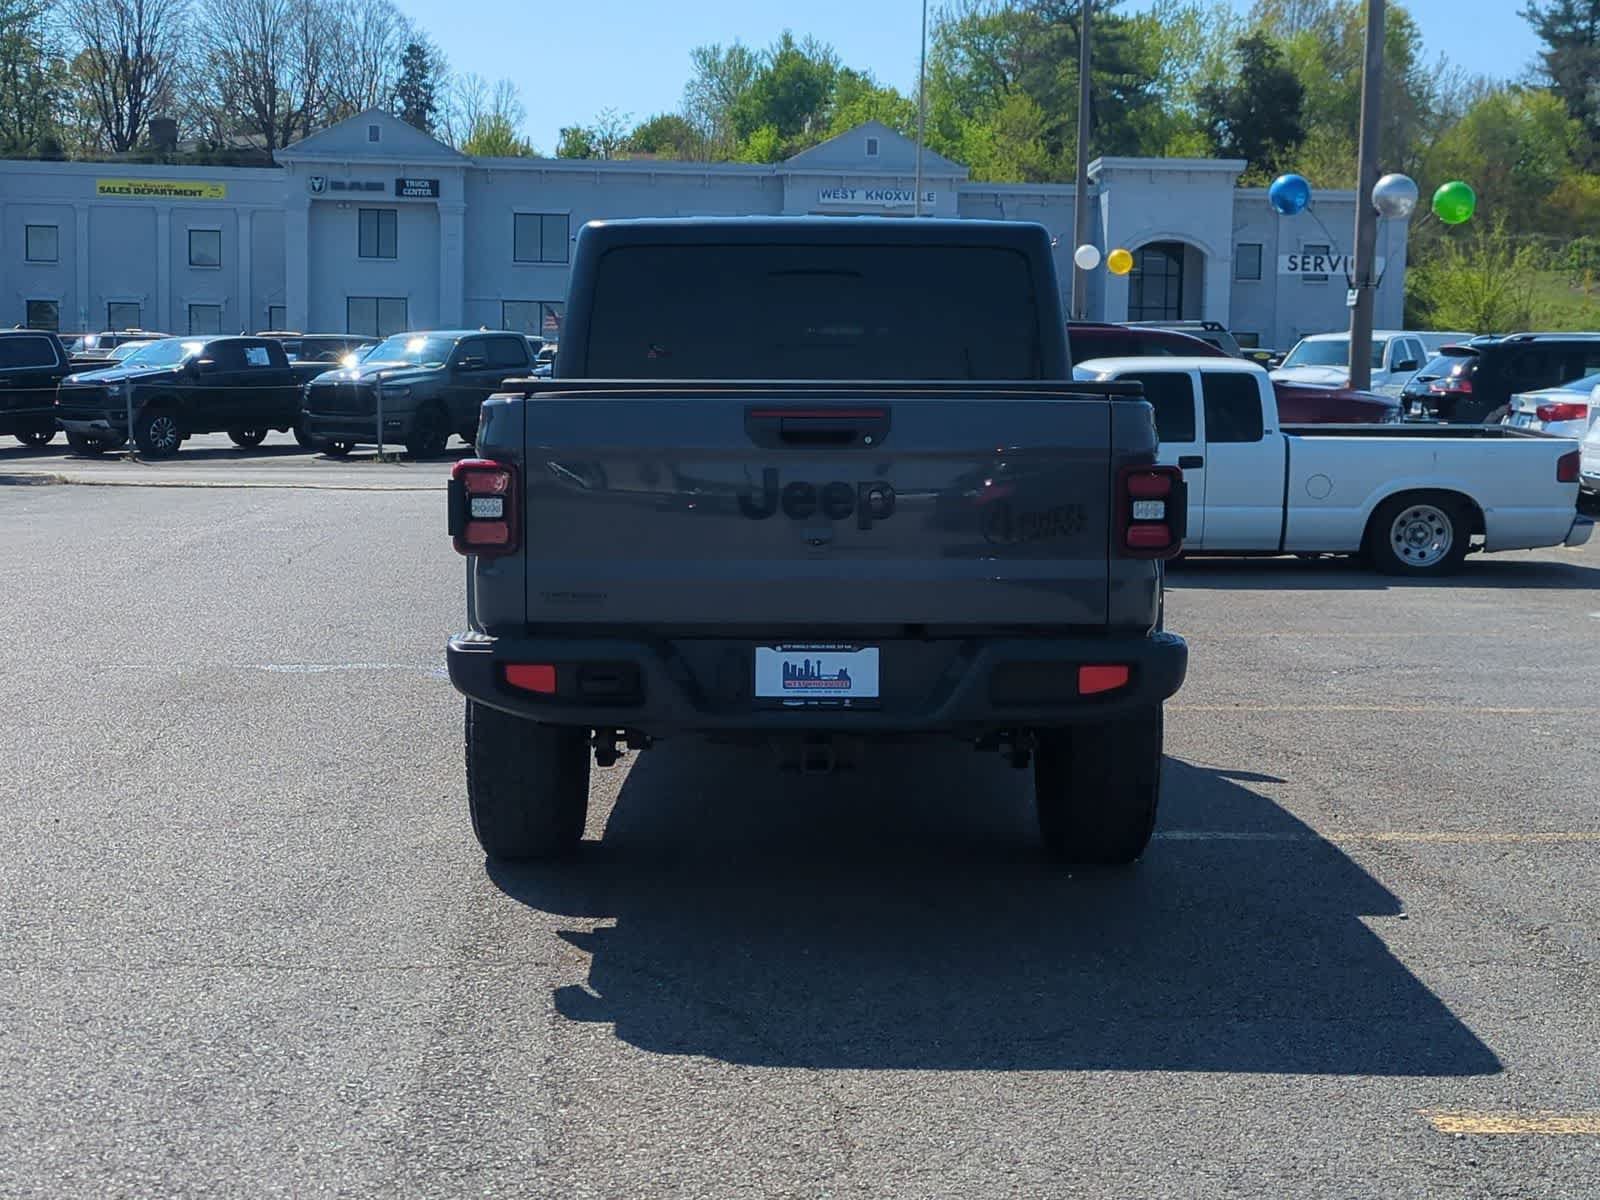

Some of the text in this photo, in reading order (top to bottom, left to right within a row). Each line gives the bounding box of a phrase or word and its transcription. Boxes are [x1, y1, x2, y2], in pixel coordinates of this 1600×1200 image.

[98, 185, 132, 195] SALES
[133, 187, 204, 197] DEPARTMENT
[820, 189, 936, 202] WEST KNOXVILE
[738, 467, 896, 530] Jeep
